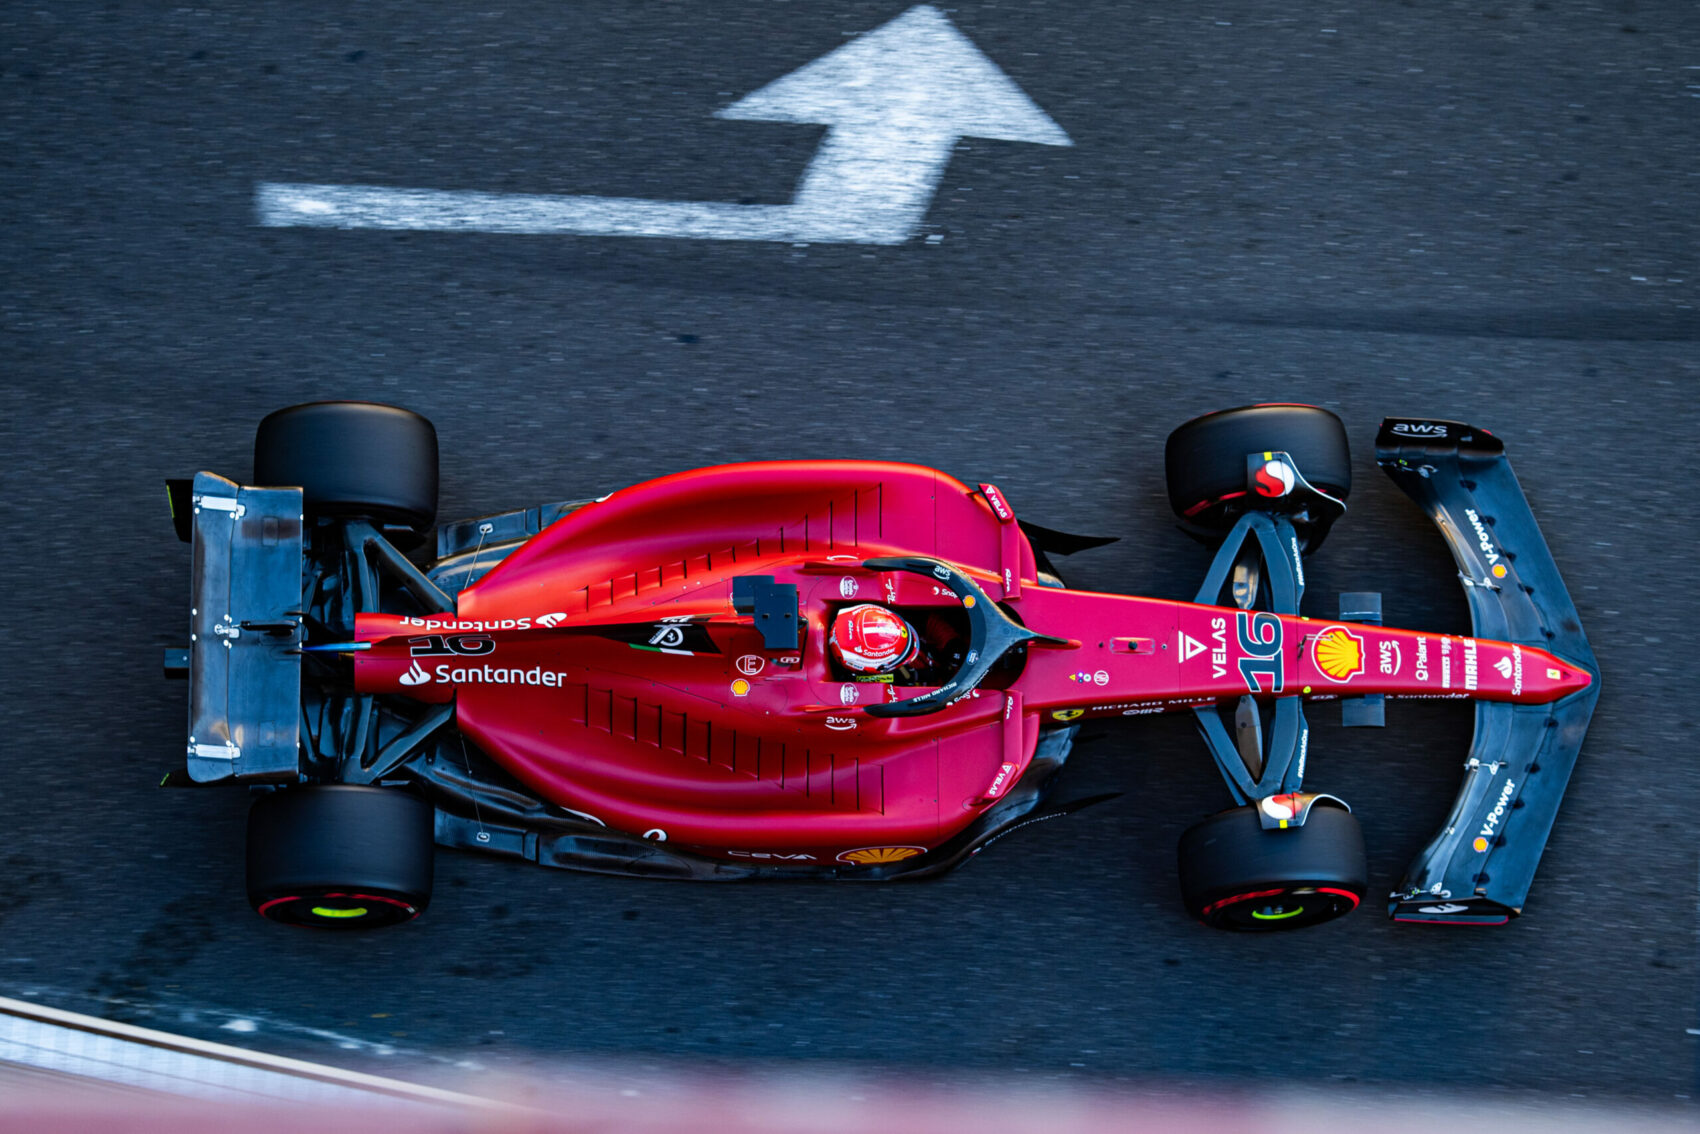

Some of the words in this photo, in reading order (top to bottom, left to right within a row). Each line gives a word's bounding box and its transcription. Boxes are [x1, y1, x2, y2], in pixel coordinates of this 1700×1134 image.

[1392, 422, 1448, 434] aws
[990, 494, 1008, 519] VELAS
[1465, 508, 1500, 565] V-Power
[934, 565, 951, 577] aws
[400, 616, 531, 632] Santander
[408, 634, 496, 657] 16
[1211, 617, 1227, 679] VELAS
[1236, 612, 1285, 693] 16
[1379, 640, 1394, 675] aws
[436, 664, 567, 687] Santander
[1463, 638, 1478, 691] MAHLE
[1512, 644, 1522, 696] Santander
[988, 773, 1006, 796] VELAS
[1480, 778, 1515, 837] V-Power
[727, 849, 818, 861] CEVA
